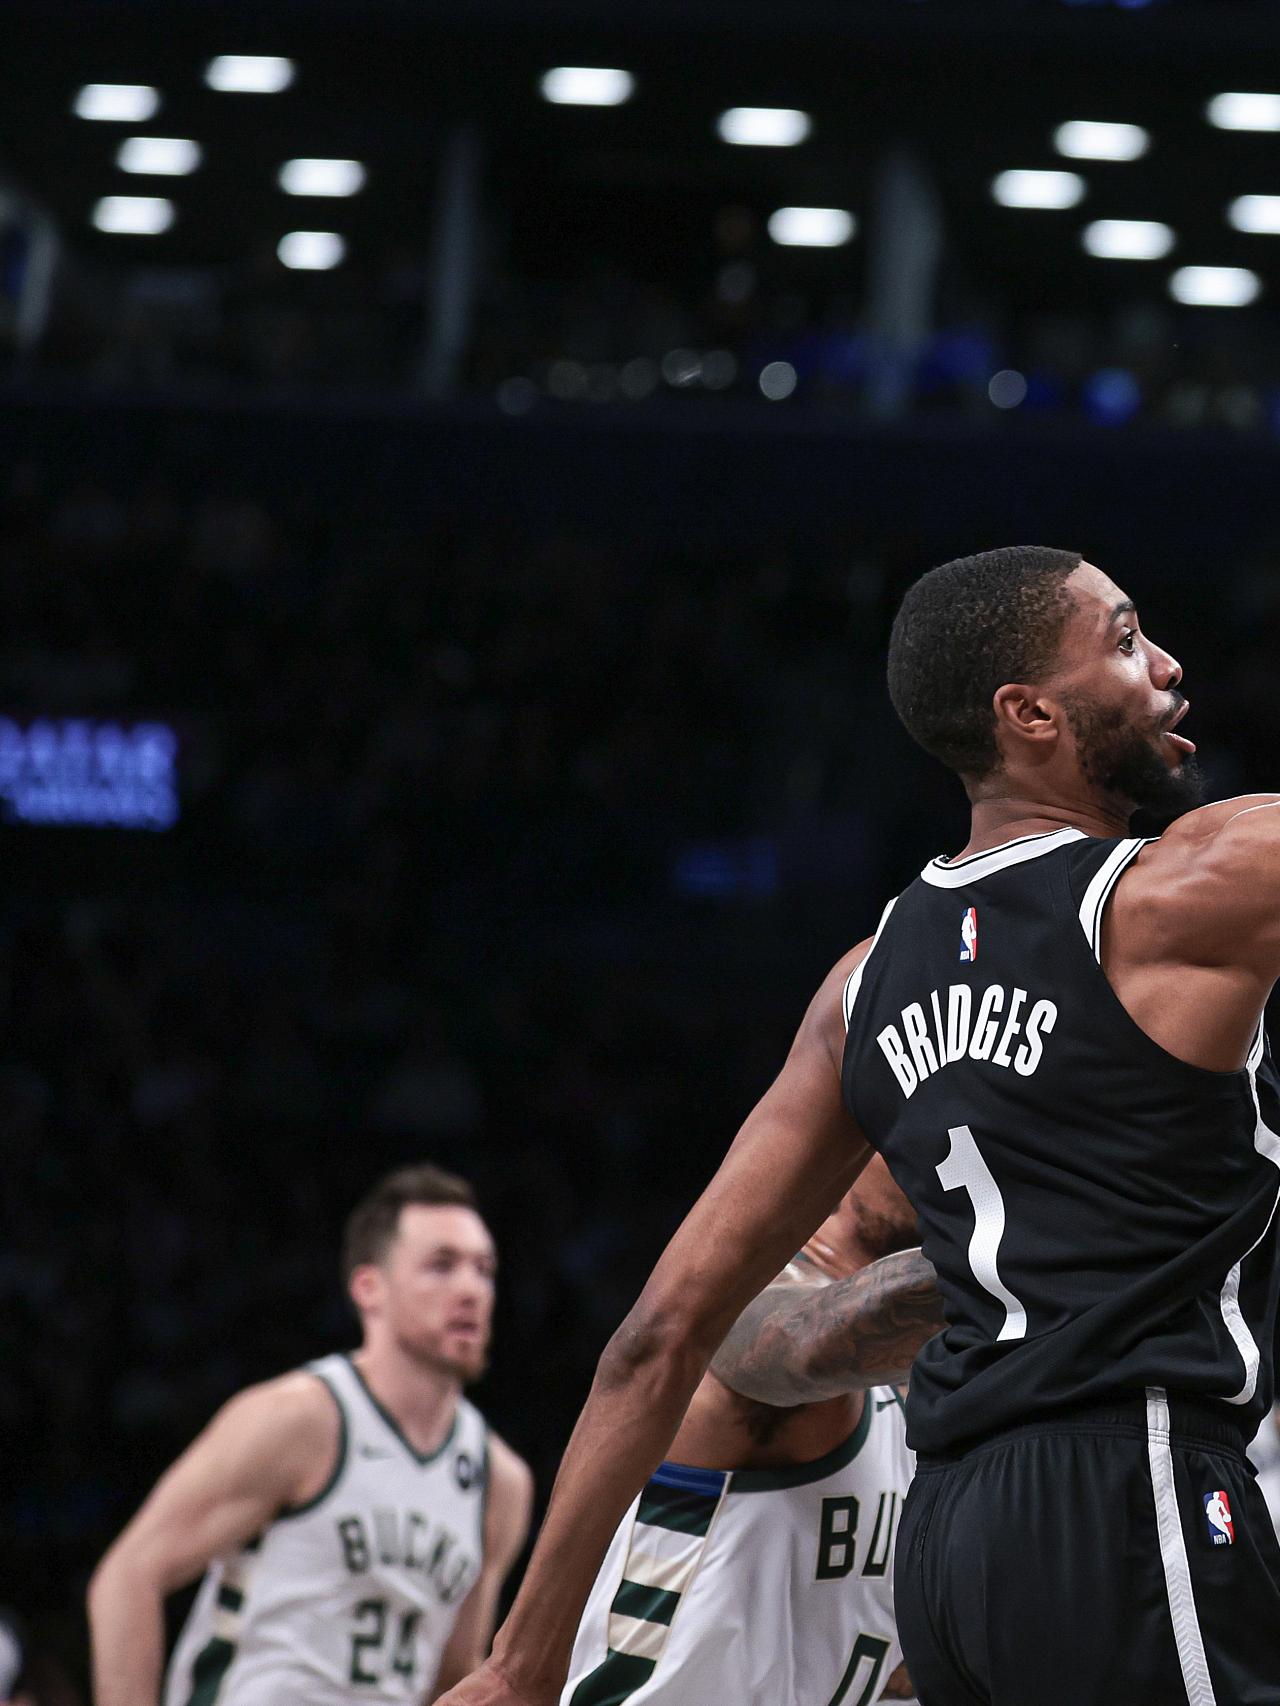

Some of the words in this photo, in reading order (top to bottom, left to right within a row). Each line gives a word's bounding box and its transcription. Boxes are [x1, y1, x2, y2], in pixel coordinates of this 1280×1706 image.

[877, 984, 1058, 1099] BRIDGES
[935, 1126, 1027, 1342] 1
[815, 1491, 905, 1581] BU
